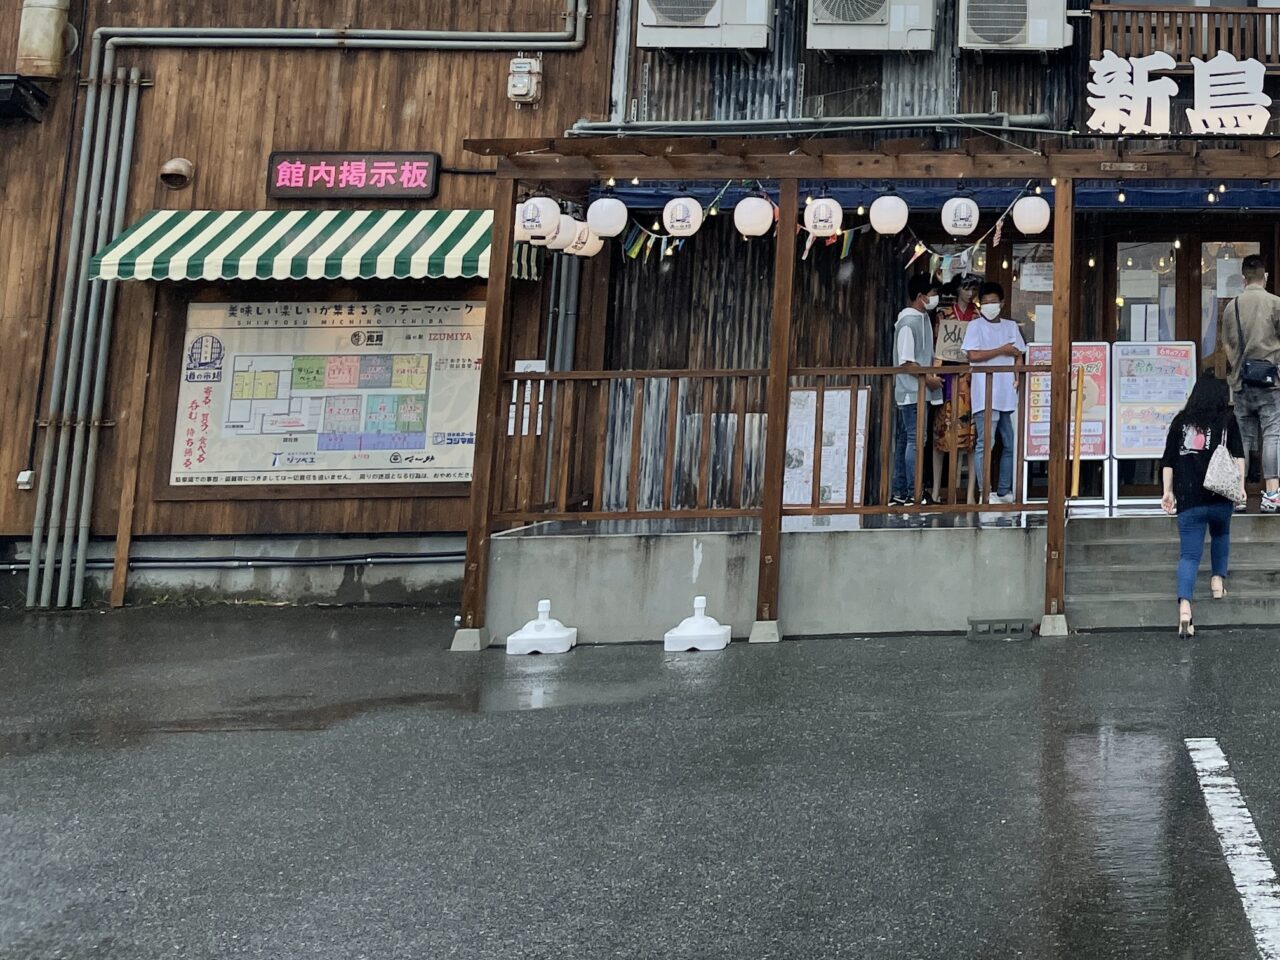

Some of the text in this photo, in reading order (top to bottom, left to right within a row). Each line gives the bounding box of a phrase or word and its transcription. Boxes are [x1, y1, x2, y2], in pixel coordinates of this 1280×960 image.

[276, 160, 429, 190] 館内掲示板
[429, 332, 472, 341] IZUMIYA
